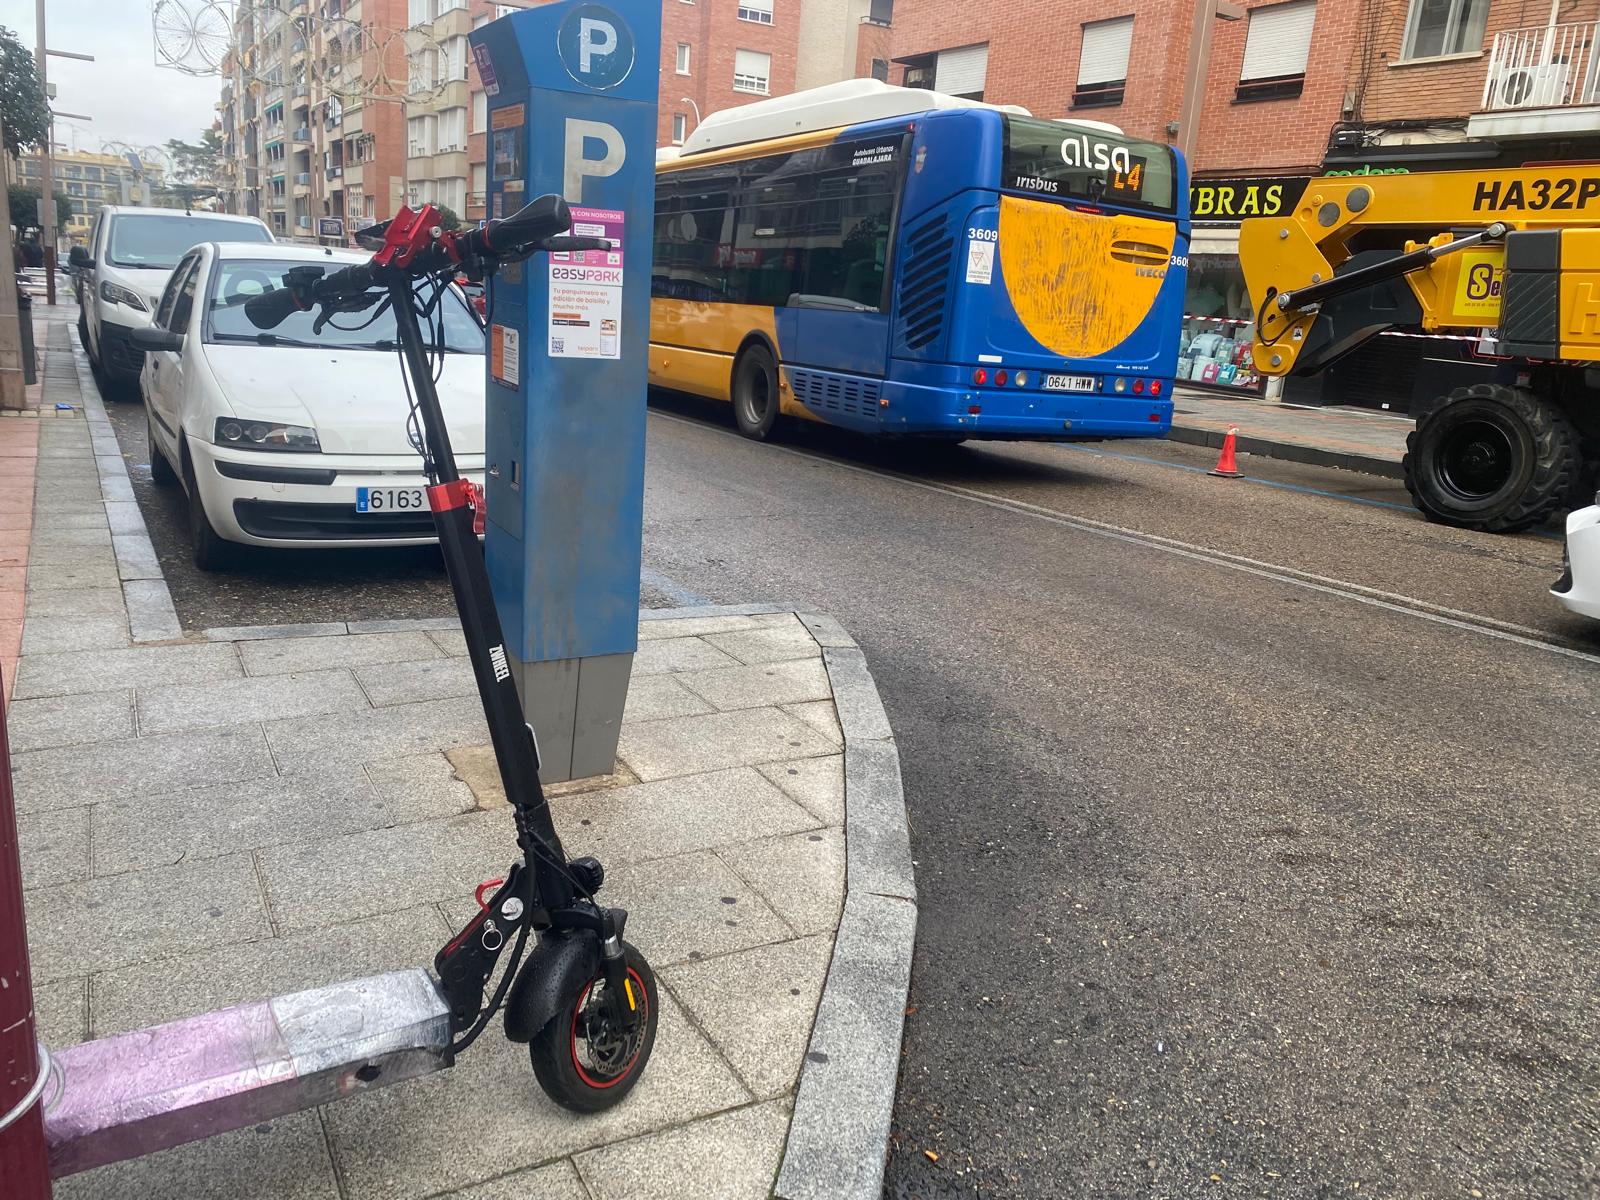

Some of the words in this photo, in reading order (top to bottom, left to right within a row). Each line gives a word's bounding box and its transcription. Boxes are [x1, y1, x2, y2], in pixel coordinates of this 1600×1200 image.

[580, 17, 617, 73] P
[563, 117, 626, 204] P
[852, 154, 892, 166] GUADALAJARA
[1061, 135, 1129, 174] alsa
[1113, 160, 1141, 191] L4
[1190, 184, 1283, 216] BRAS
[591, 212, 621, 220] NOSOTROS
[968, 228, 998, 241] 3609
[1135, 267, 1166, 279] IVECO
[1048, 376, 1072, 388] 0641
[370, 490, 422, 508] 6163
